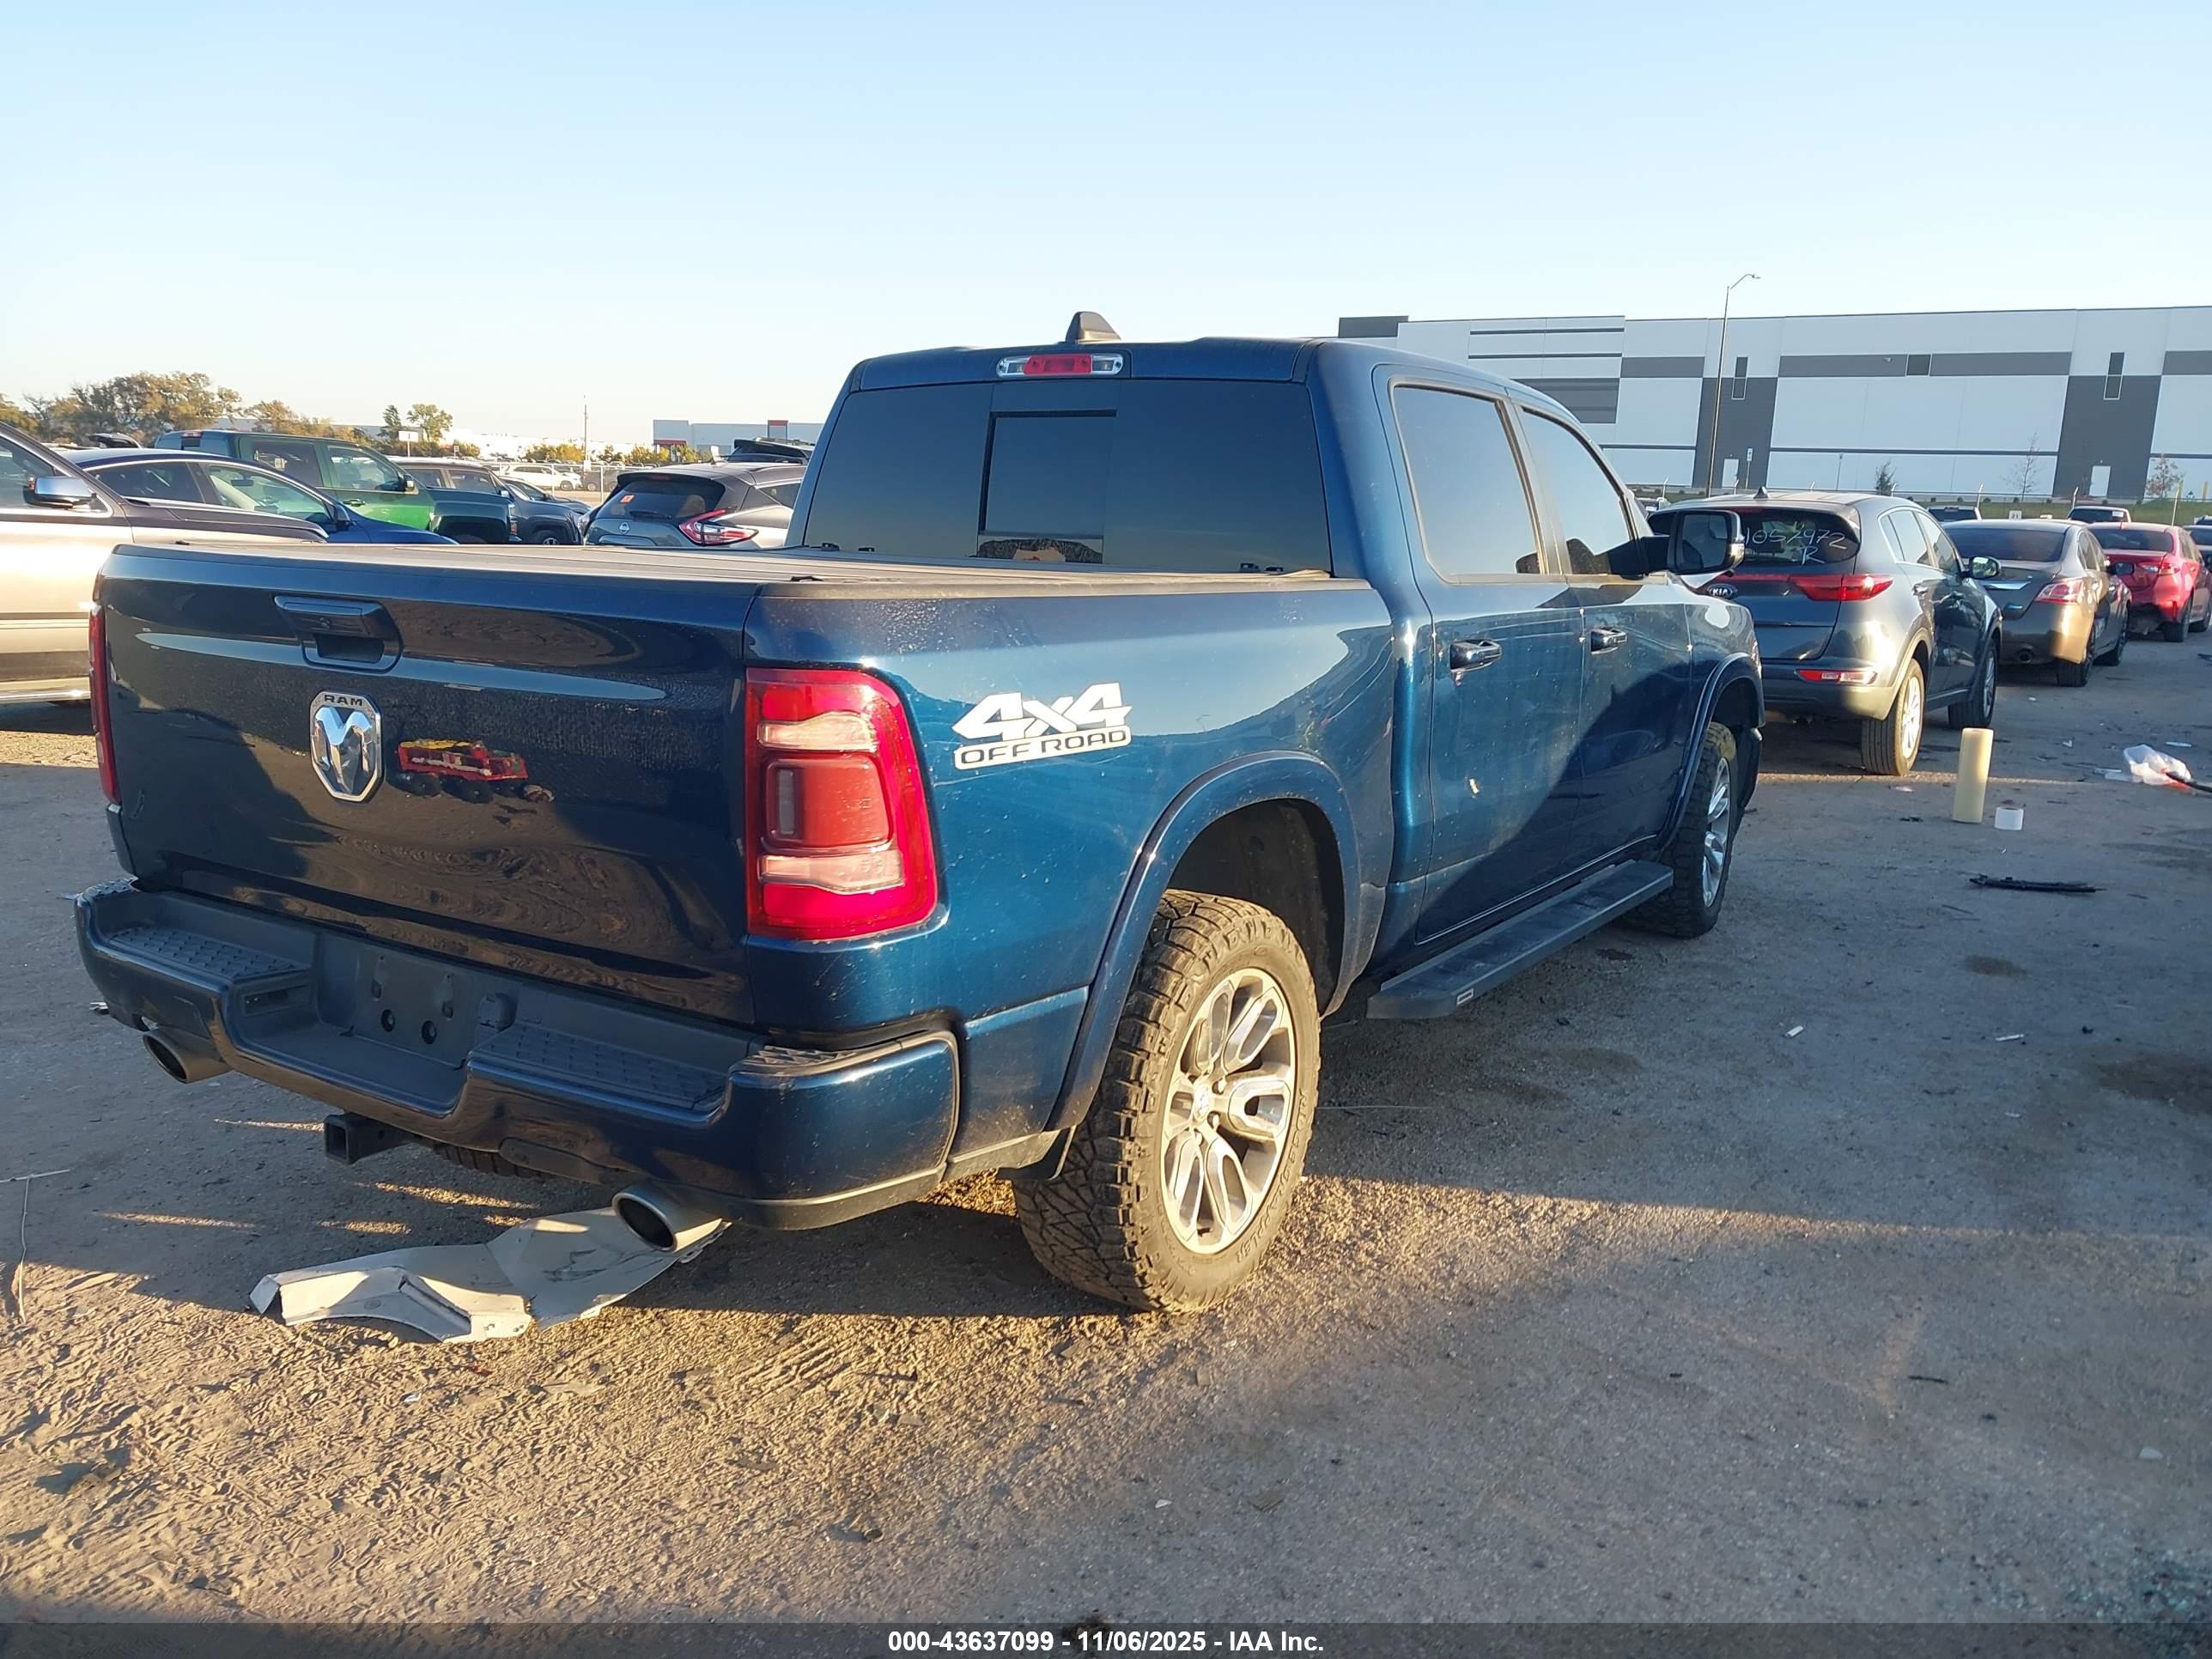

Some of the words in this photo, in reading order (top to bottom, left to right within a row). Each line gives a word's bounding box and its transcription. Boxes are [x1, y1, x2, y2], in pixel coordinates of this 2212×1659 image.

[324, 694, 363, 707] RAM
[960, 743, 1031, 765] OFF
[1041, 729, 1127, 754] ROAD
[1236, 1164, 1291, 1264] GRAPPLER
